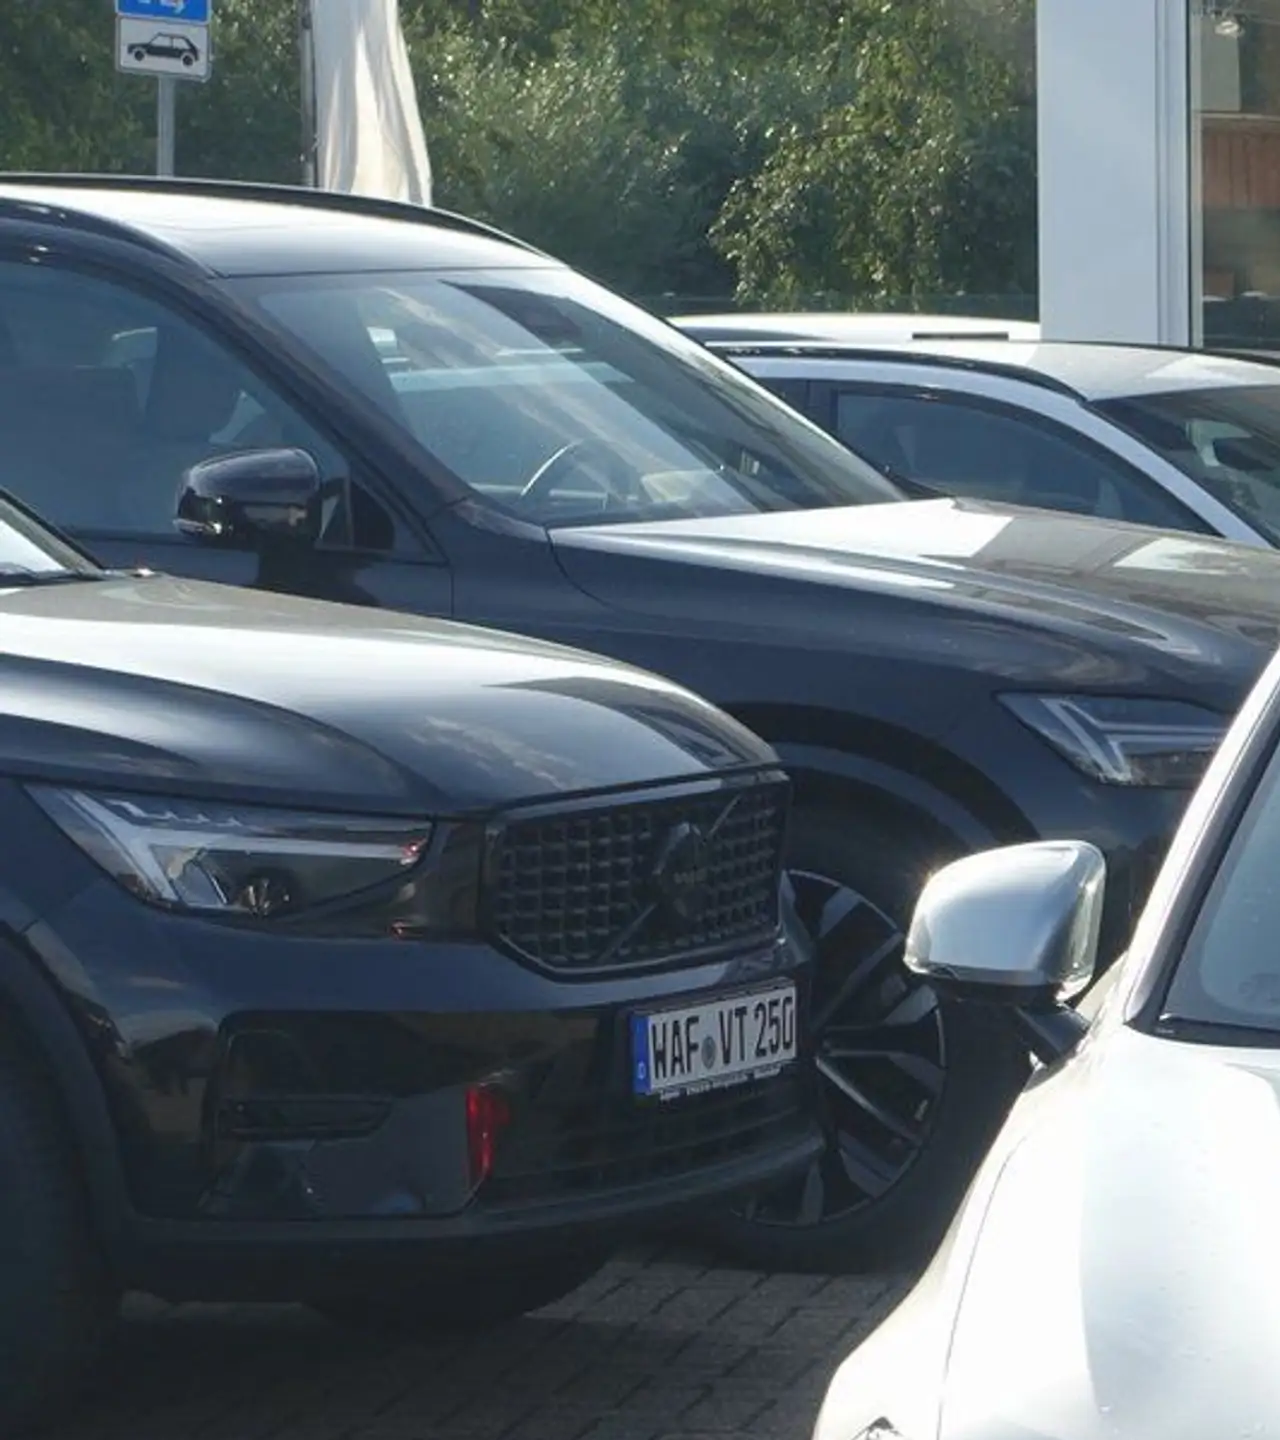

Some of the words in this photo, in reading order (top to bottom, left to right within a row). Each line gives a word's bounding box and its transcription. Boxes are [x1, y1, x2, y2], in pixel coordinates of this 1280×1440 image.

[652, 1016, 699, 1079] WAF
[719, 1005, 747, 1064] VT
[754, 996, 793, 1058] 250
